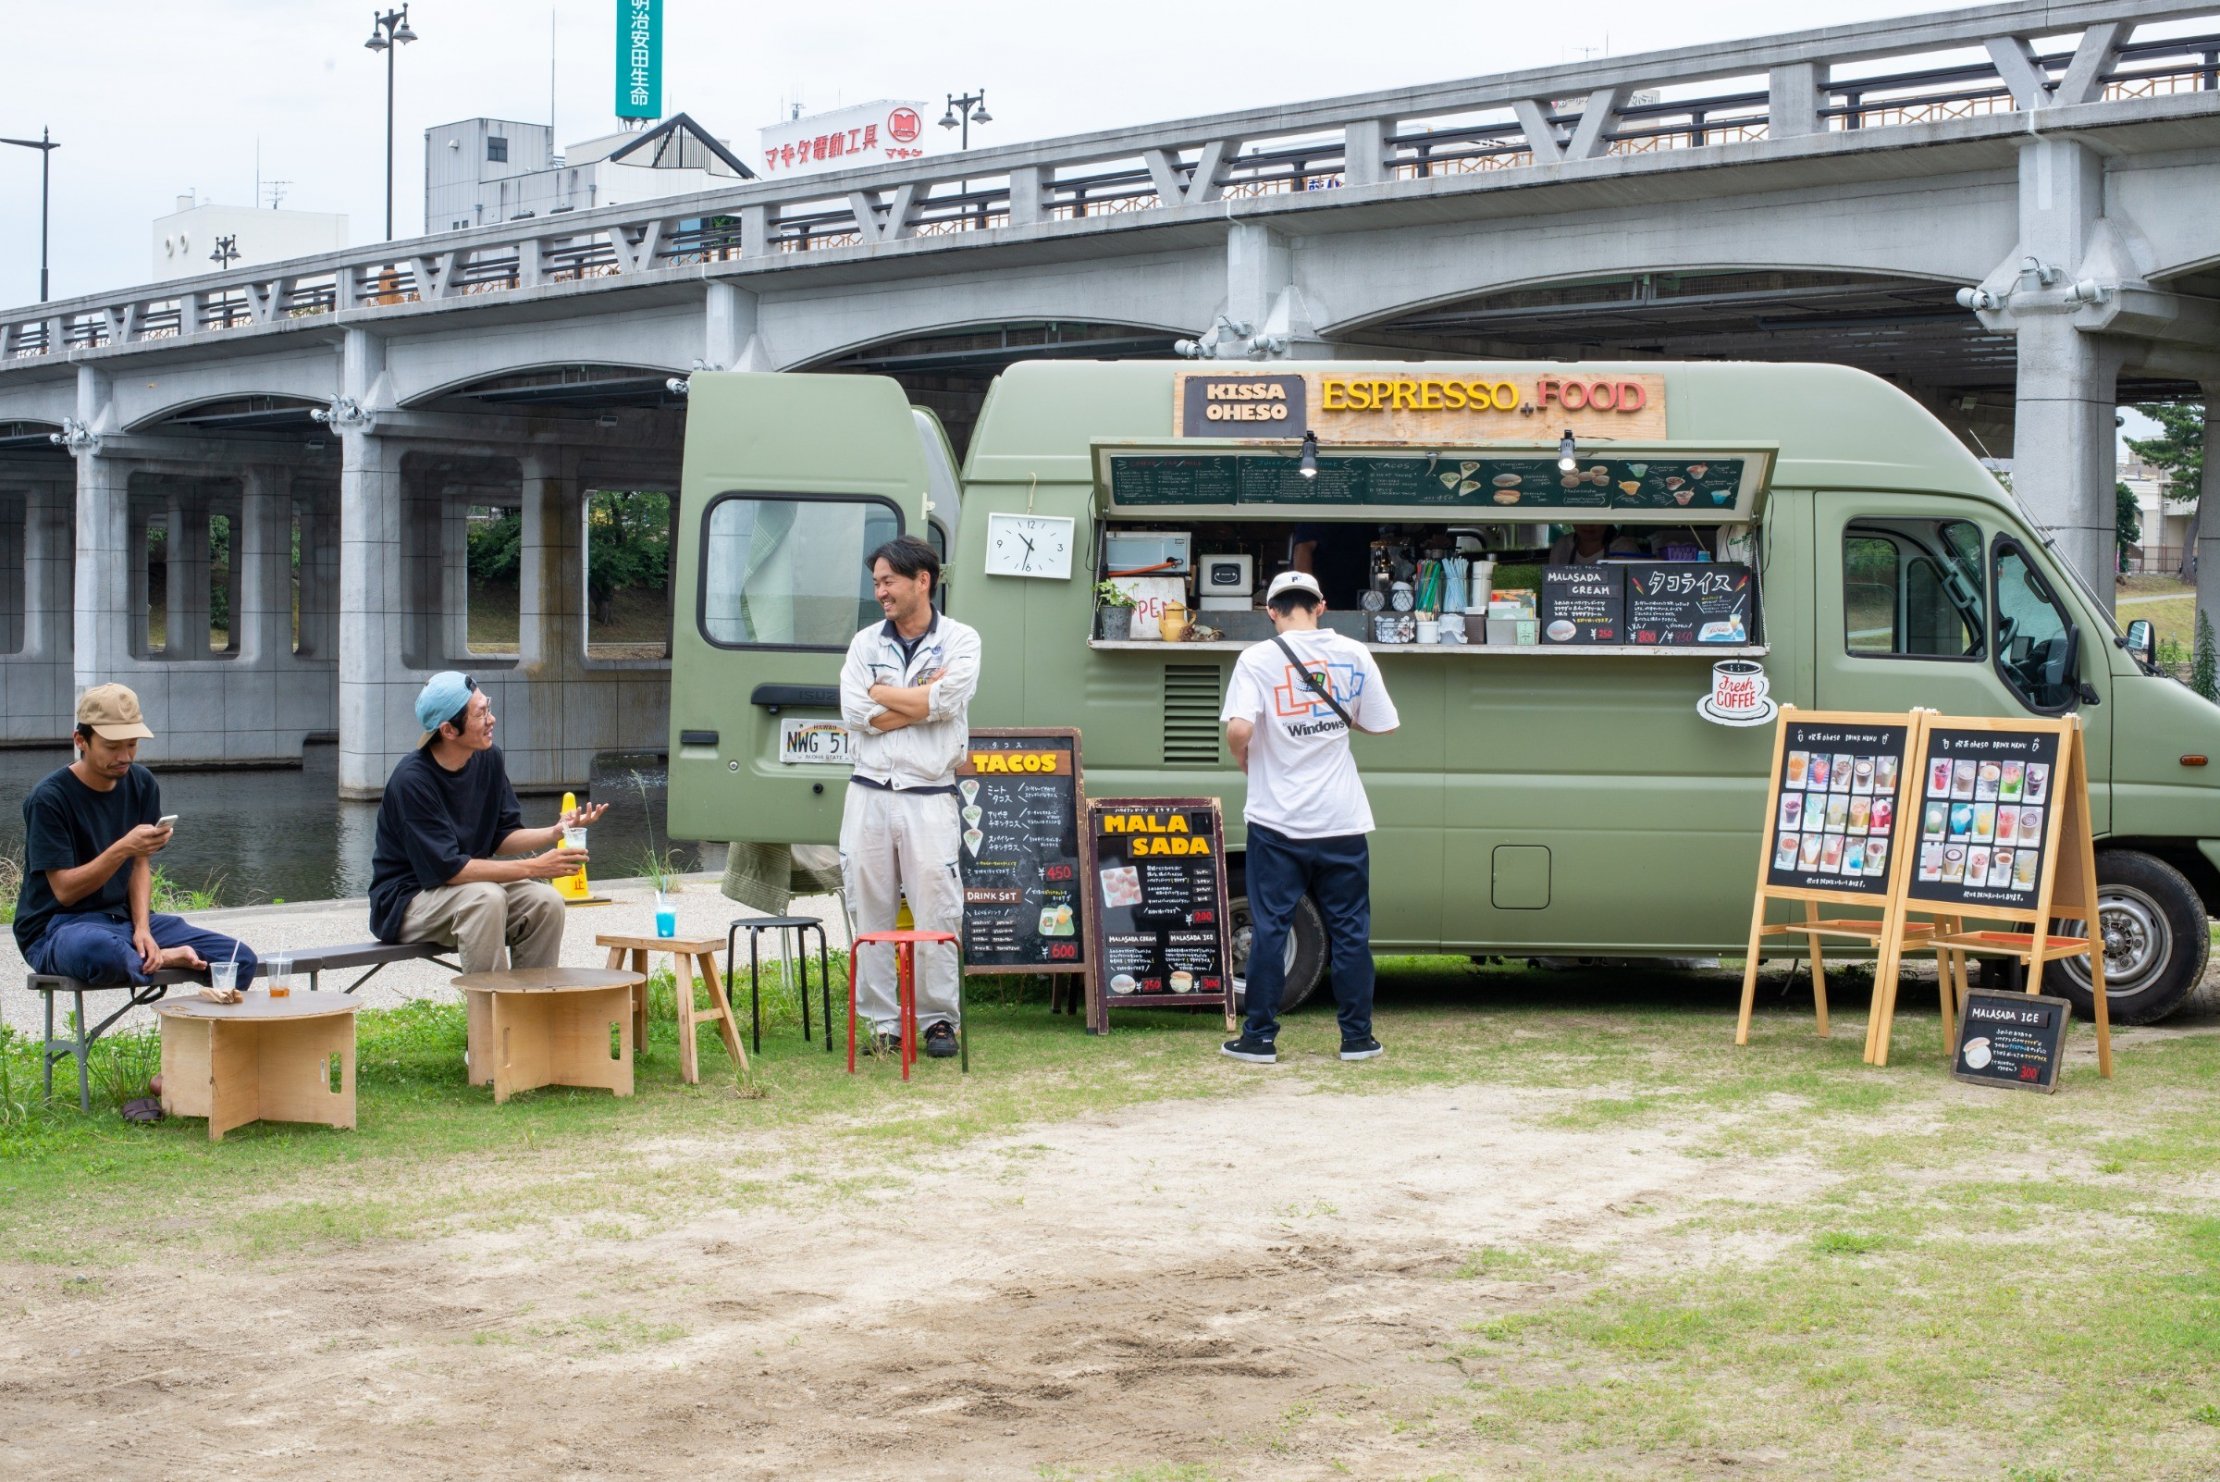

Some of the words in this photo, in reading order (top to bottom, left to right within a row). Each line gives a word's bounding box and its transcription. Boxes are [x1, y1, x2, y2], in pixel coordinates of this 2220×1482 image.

[630, 0, 650, 106] 明治安田生命
[765, 124, 878, 171] マキタ電動工具
[885, 148, 923, 159] マキタ
[1207, 383, 1287, 400] KISSA
[1322, 380, 1519, 412] ESPRESSO
[1536, 380, 1648, 413] FOOD
[1206, 403, 1288, 421] OHESO
[1027, 520, 1036, 529] 12
[996, 539, 1003, 548] 9
[1057, 543, 1064, 552] 3
[1025, 563, 1032, 572] 6
[1547, 572, 1602, 582] MALASADA
[1648, 570, 1733, 596] タコライス
[1571, 585, 1610, 595] CREAM
[1719, 675, 1756, 692] Fresh
[1716, 690, 1756, 708] COFFEE
[1287, 720, 1345, 736] Windows
[787, 731, 818, 753] NWG
[830, 732, 849, 753] 51
[972, 753, 1058, 773] TACOS
[988, 785, 1007, 796] ミート
[992, 794, 1013, 805] タコス
[1104, 815, 1189, 833] MALA
[1132, 837, 1211, 856] SADA
[967, 892, 997, 901] DRINK
[1109, 935, 1139, 944] MALASADA
[1170, 934, 1201, 942] MALASADA
[1971, 1007, 2016, 1020] MALASADA
[2021, 1012, 2039, 1023] ICE
